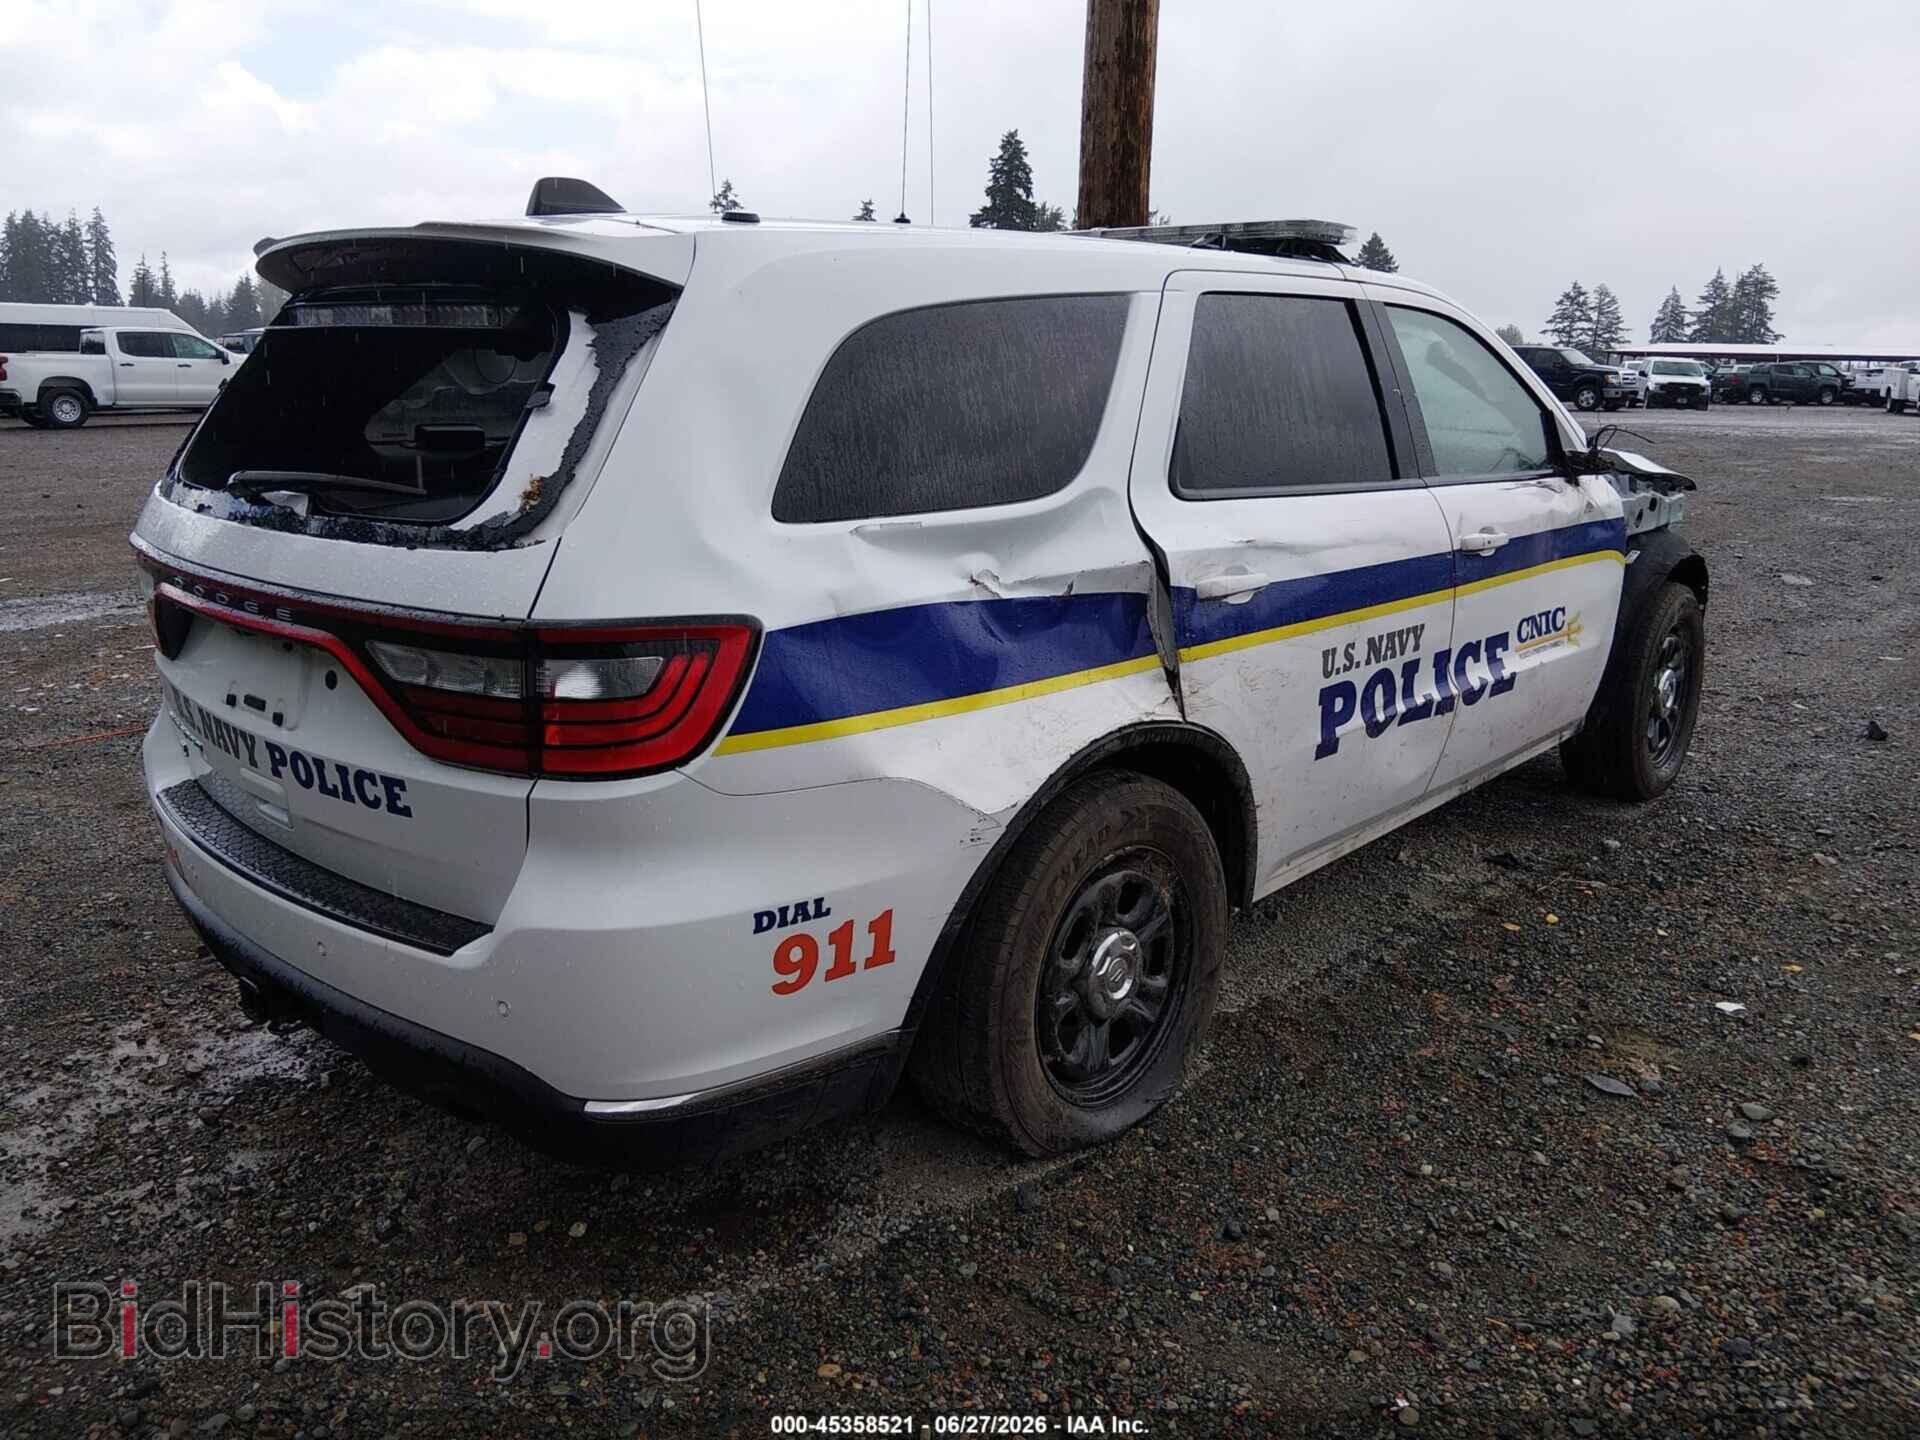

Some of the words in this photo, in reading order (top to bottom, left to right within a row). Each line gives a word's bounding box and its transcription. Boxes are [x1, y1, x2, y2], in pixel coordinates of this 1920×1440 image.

[1321, 642, 1361, 680] U.S.
[1364, 623, 1425, 667] NAVY
[1516, 606, 1566, 644] CNIC
[1314, 632, 1518, 761] POLICE
[197, 704, 259, 769] NAVY
[264, 740, 413, 818] POLICE
[753, 897, 832, 935] DIAL
[771, 908, 896, 996] 911
